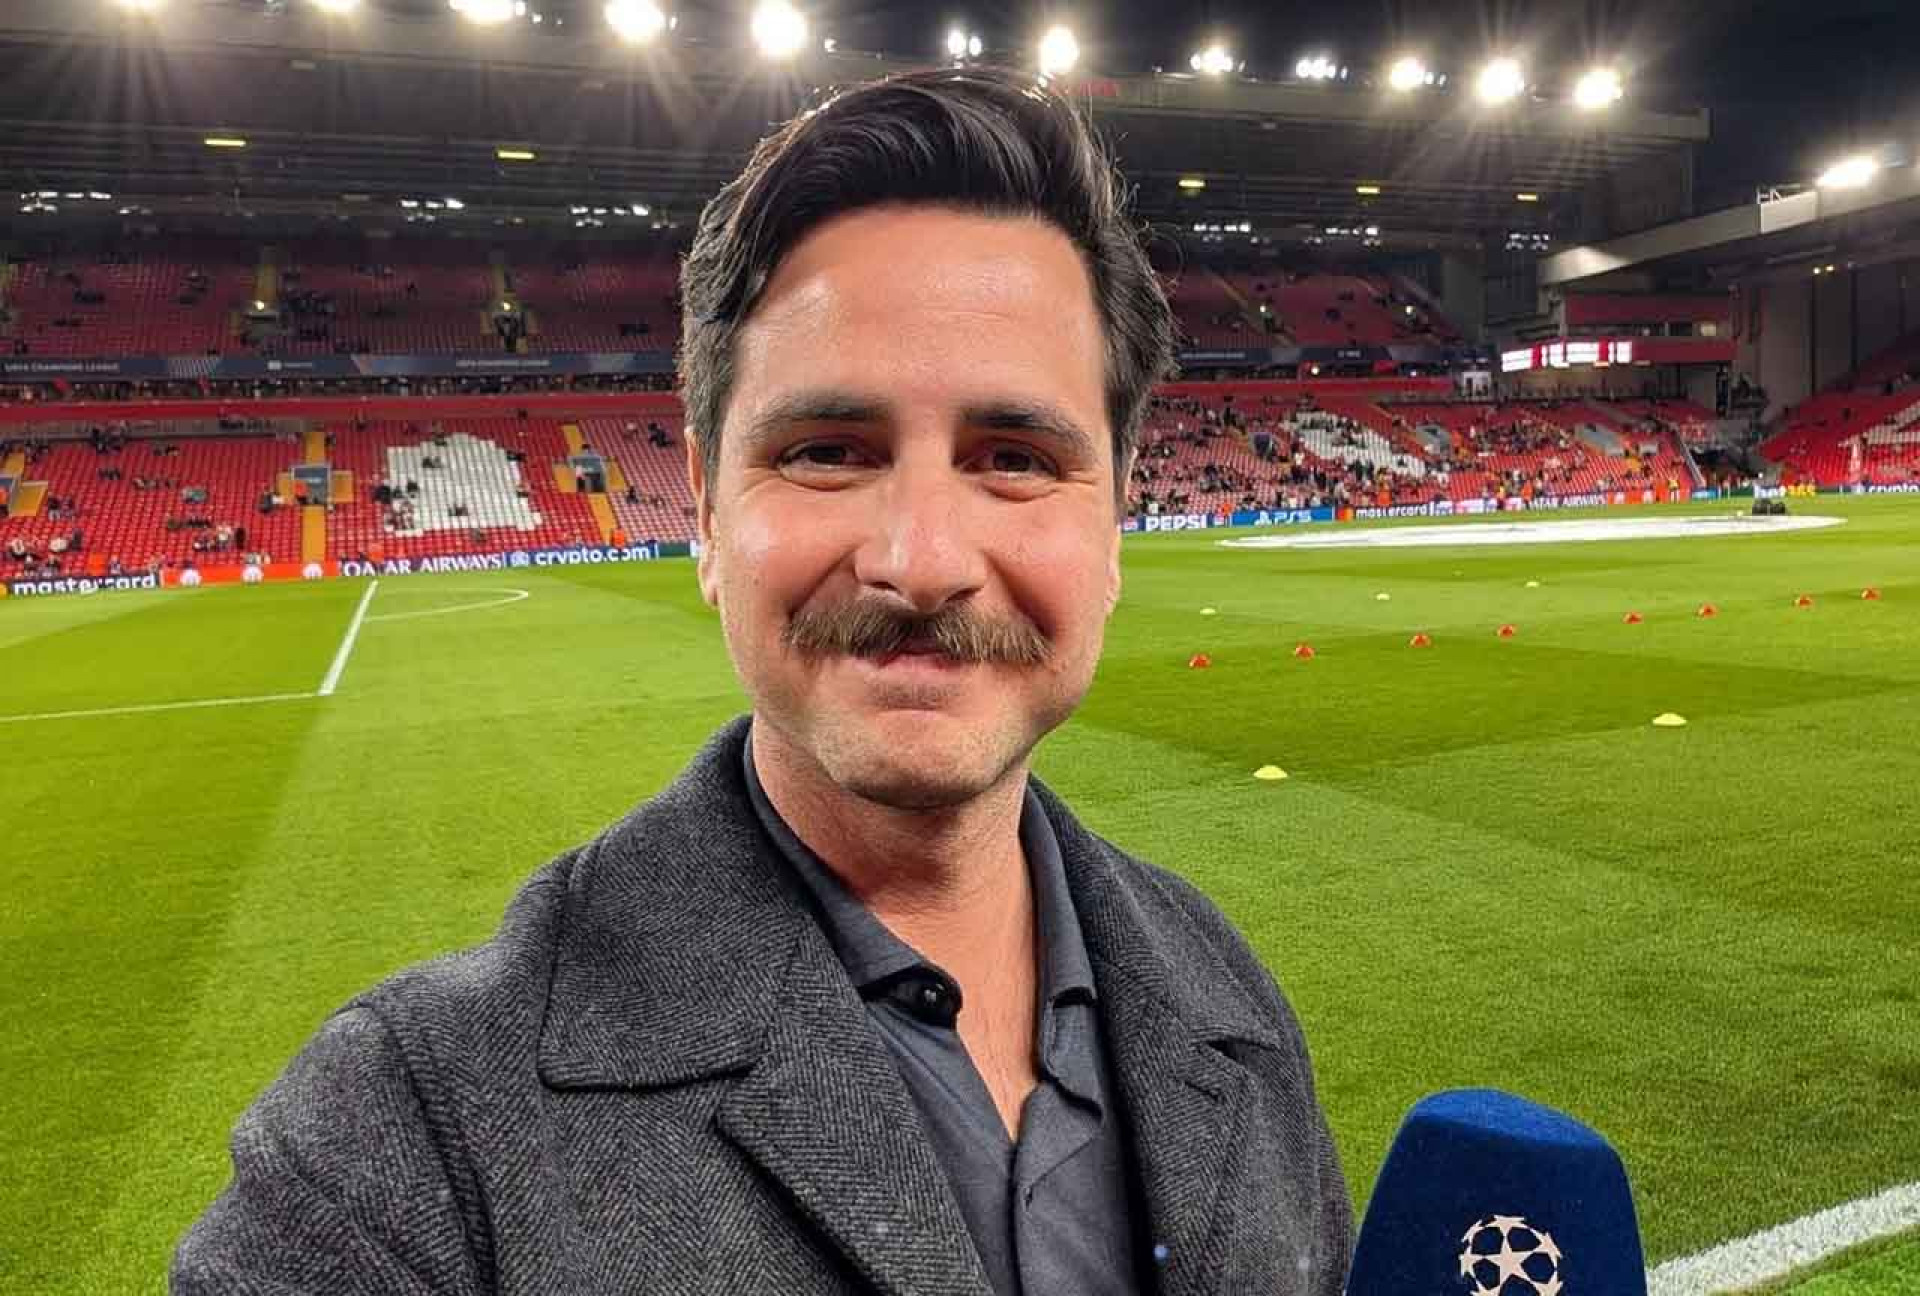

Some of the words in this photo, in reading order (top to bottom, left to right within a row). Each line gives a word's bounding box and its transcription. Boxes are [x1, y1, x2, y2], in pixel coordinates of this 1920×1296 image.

[1145, 514, 1207, 532] PEPSI
[1274, 509, 1312, 525] PS5
[343, 558, 411, 577] QAAR
[419, 553, 502, 574] AIRWAYS
[536, 545, 650, 566] crypto.com
[13, 573, 156, 596] mastercard
